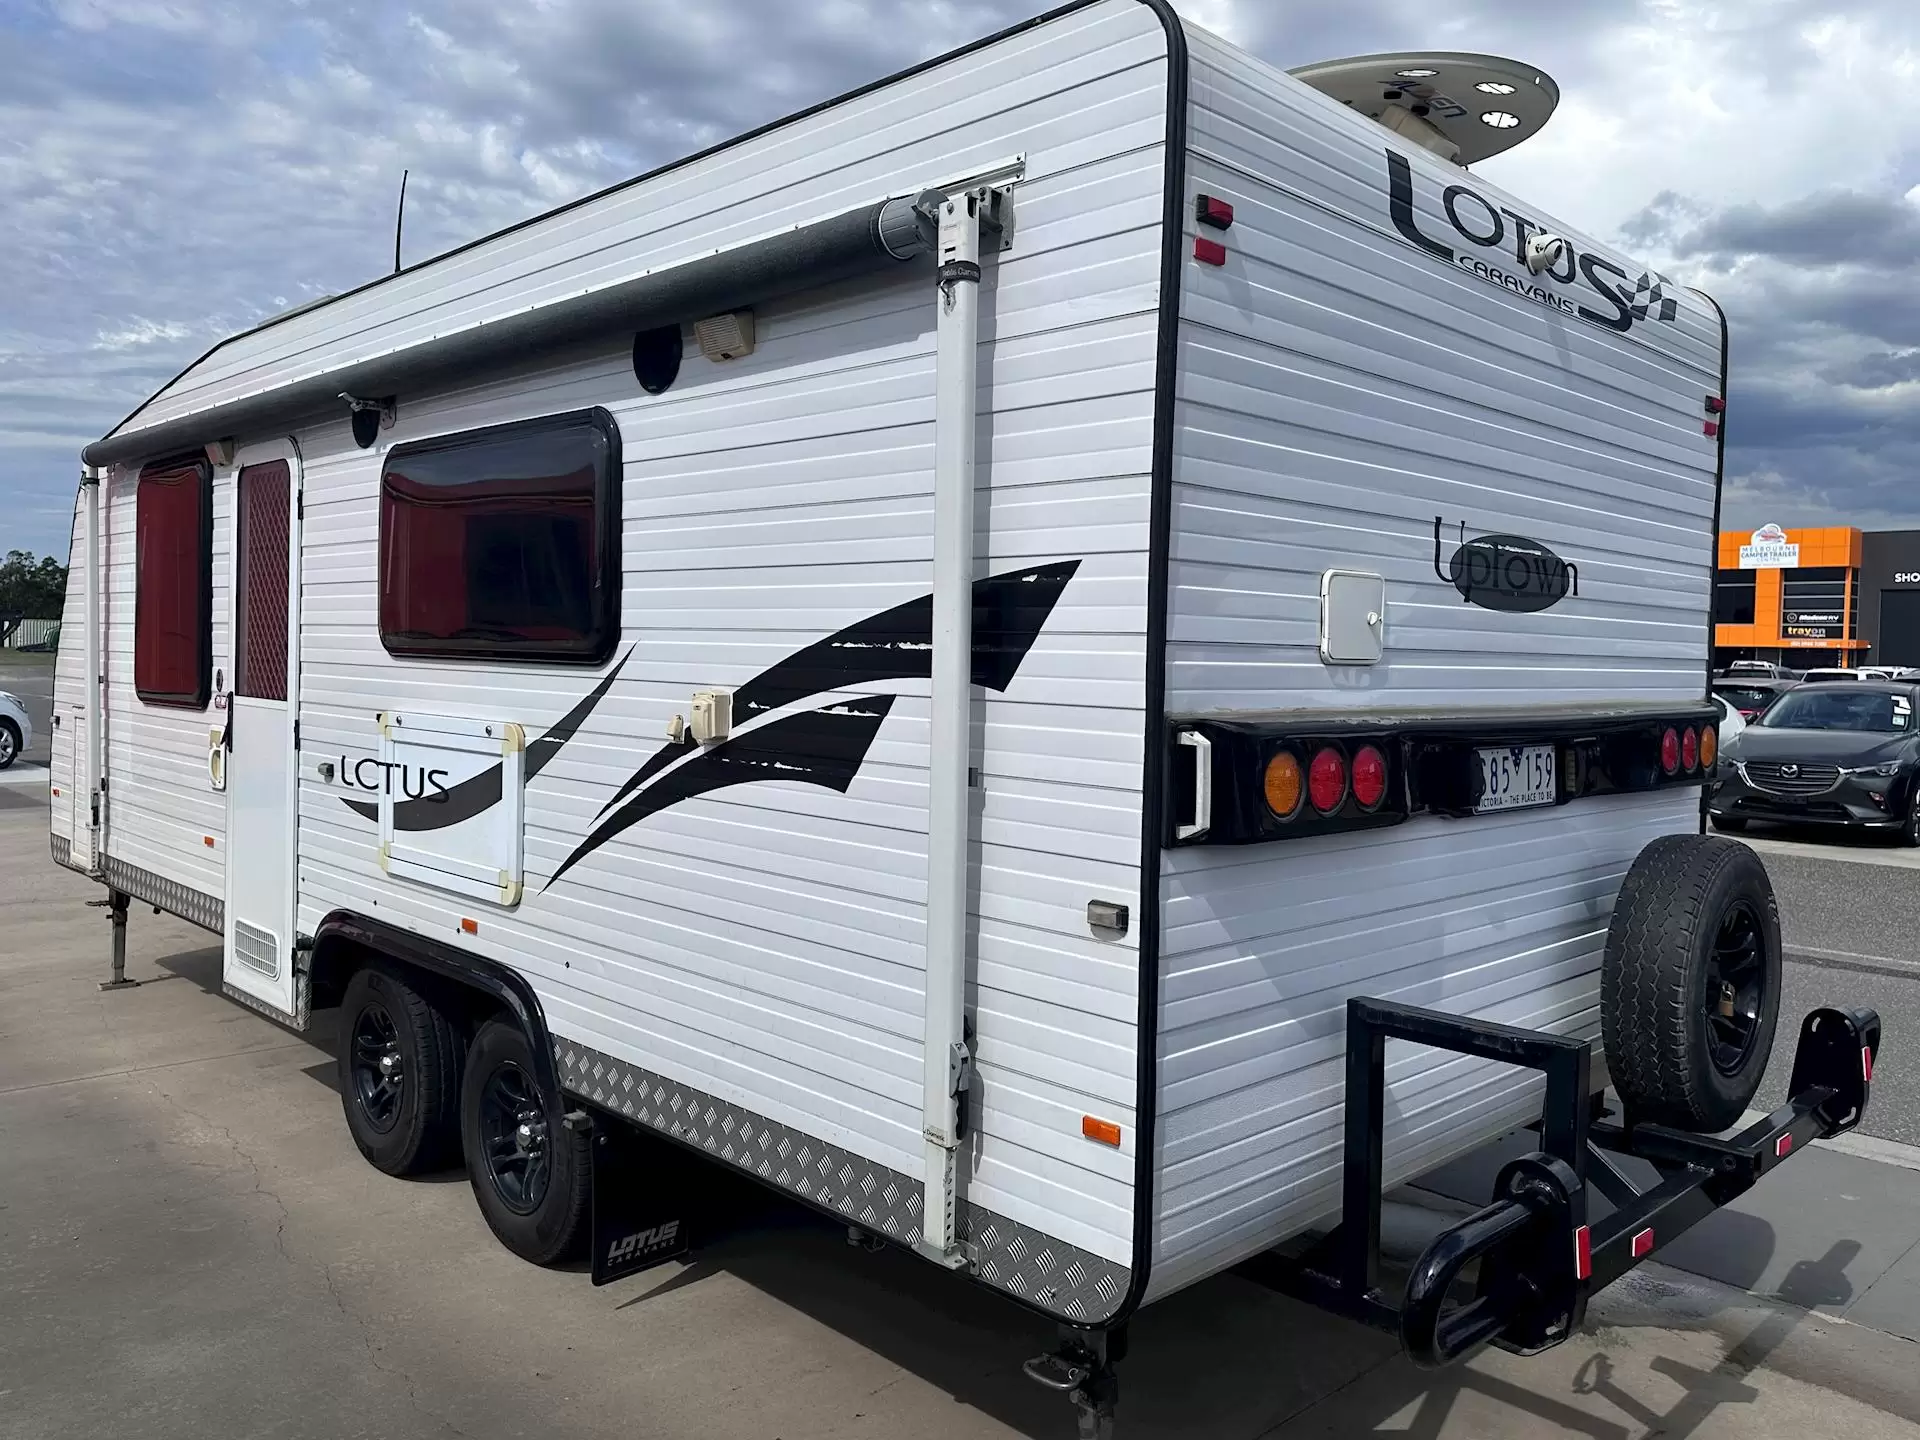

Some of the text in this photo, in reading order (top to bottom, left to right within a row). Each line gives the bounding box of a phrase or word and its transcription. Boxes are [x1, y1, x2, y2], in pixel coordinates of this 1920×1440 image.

[1459, 256, 1575, 315] CARAVANS
[1434, 516, 1579, 603] Uptown
[1787, 626, 1826, 636] trayon
[1525, 752, 1553, 792] 159
[1480, 796, 1503, 808] ICTORIA
[1510, 794, 1520, 804] THE
[1521, 792, 1536, 803] PLACE
[1538, 791, 1545, 801] TO
[1546, 790, 1552, 800] BE
[607, 1220, 680, 1259] LOTUS
[607, 1238, 675, 1267] CARAVANS
